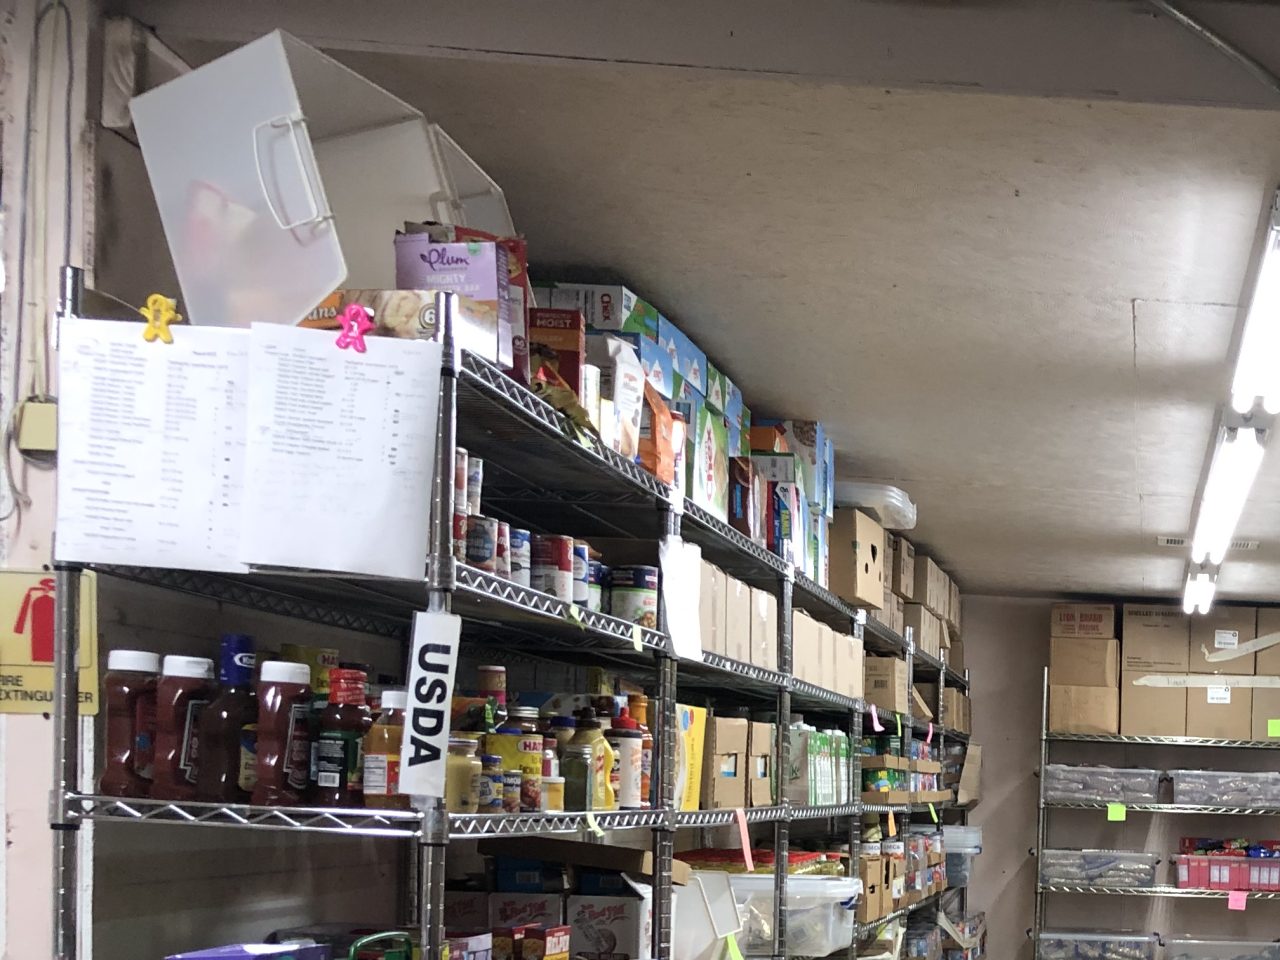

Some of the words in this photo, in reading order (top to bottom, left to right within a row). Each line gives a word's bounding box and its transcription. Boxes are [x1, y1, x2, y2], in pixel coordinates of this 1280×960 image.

[423, 248, 470, 271] Plum
[426, 274, 467, 285] MIGHTY
[600, 293, 612, 322] Chex
[536, 319, 572, 329] MOIST
[408, 643, 452, 767] USDA
